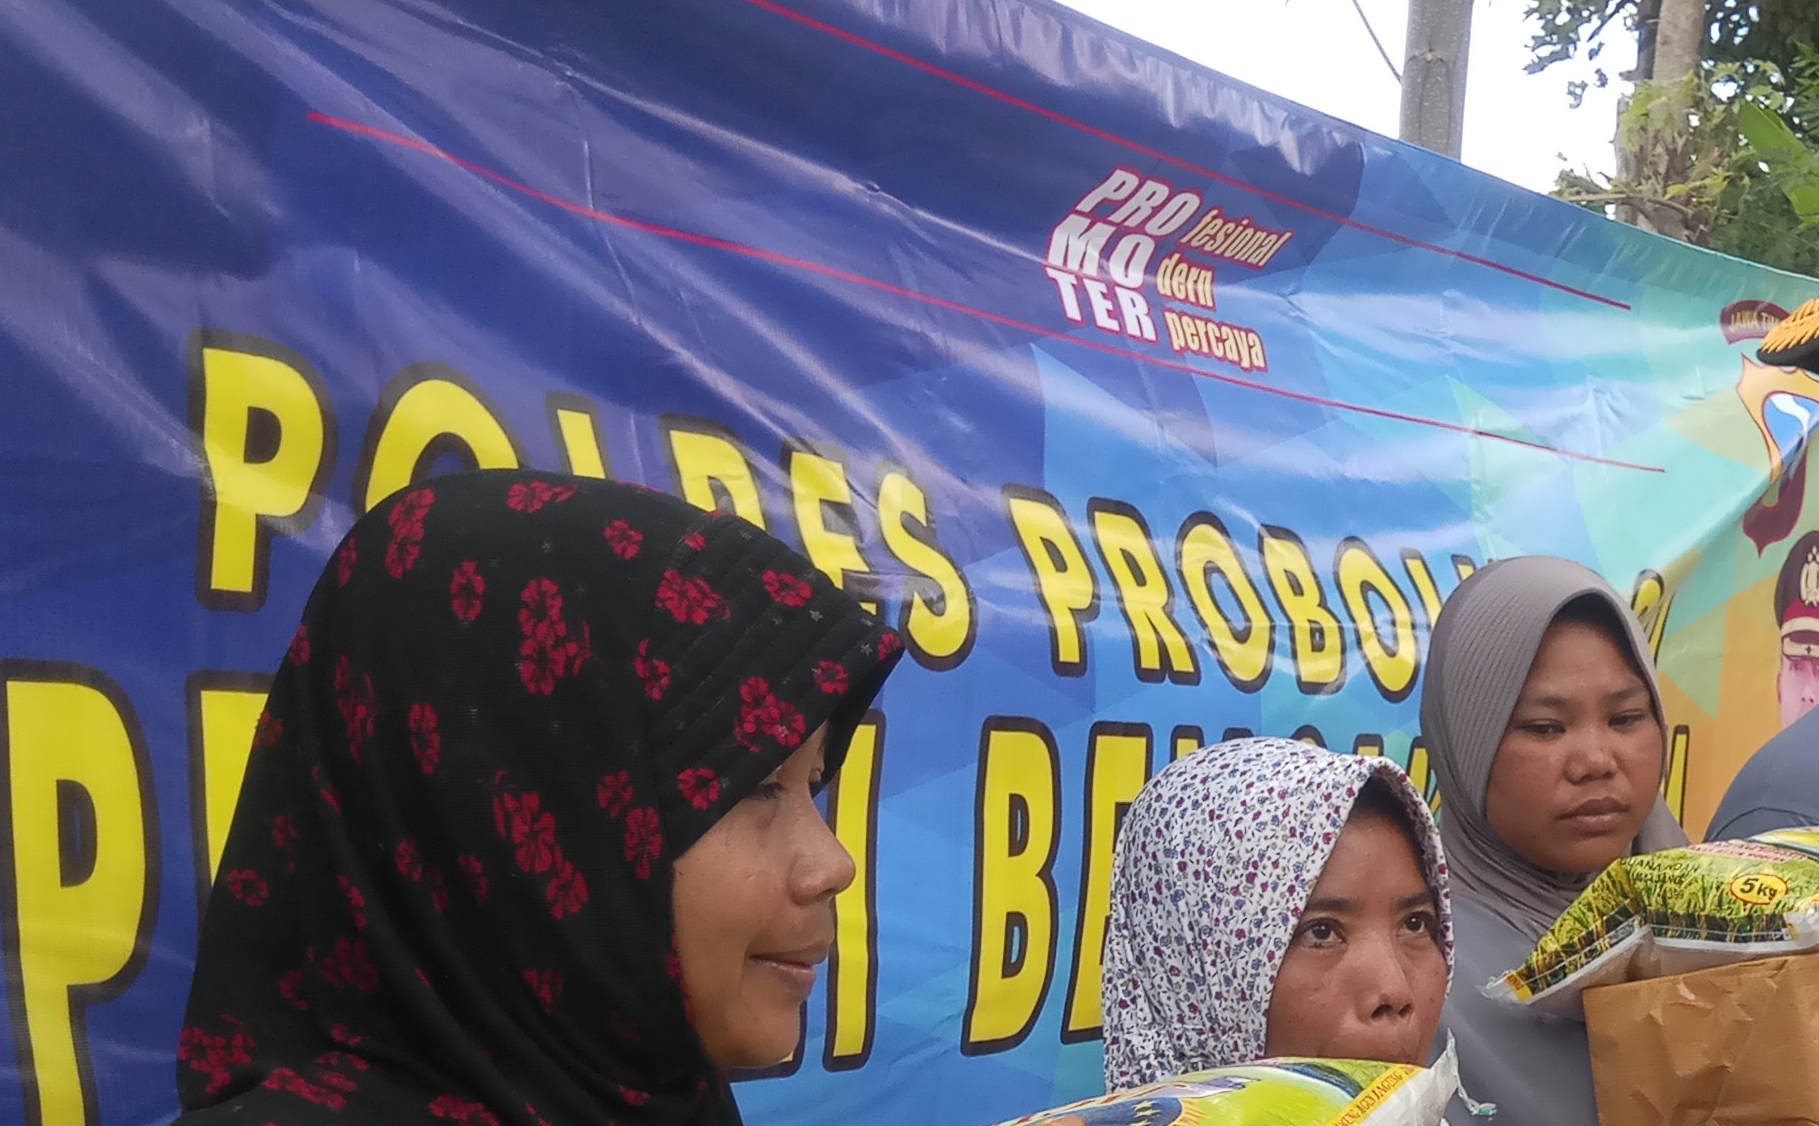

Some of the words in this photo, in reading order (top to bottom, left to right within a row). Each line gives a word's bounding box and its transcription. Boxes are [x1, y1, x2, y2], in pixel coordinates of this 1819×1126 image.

[1073, 166, 1203, 238] PRO
[1046, 212, 1157, 290] MO
[1156, 252, 1216, 309] dern
[1044, 266, 1158, 342] TER
[1163, 309, 1269, 371] percaya
